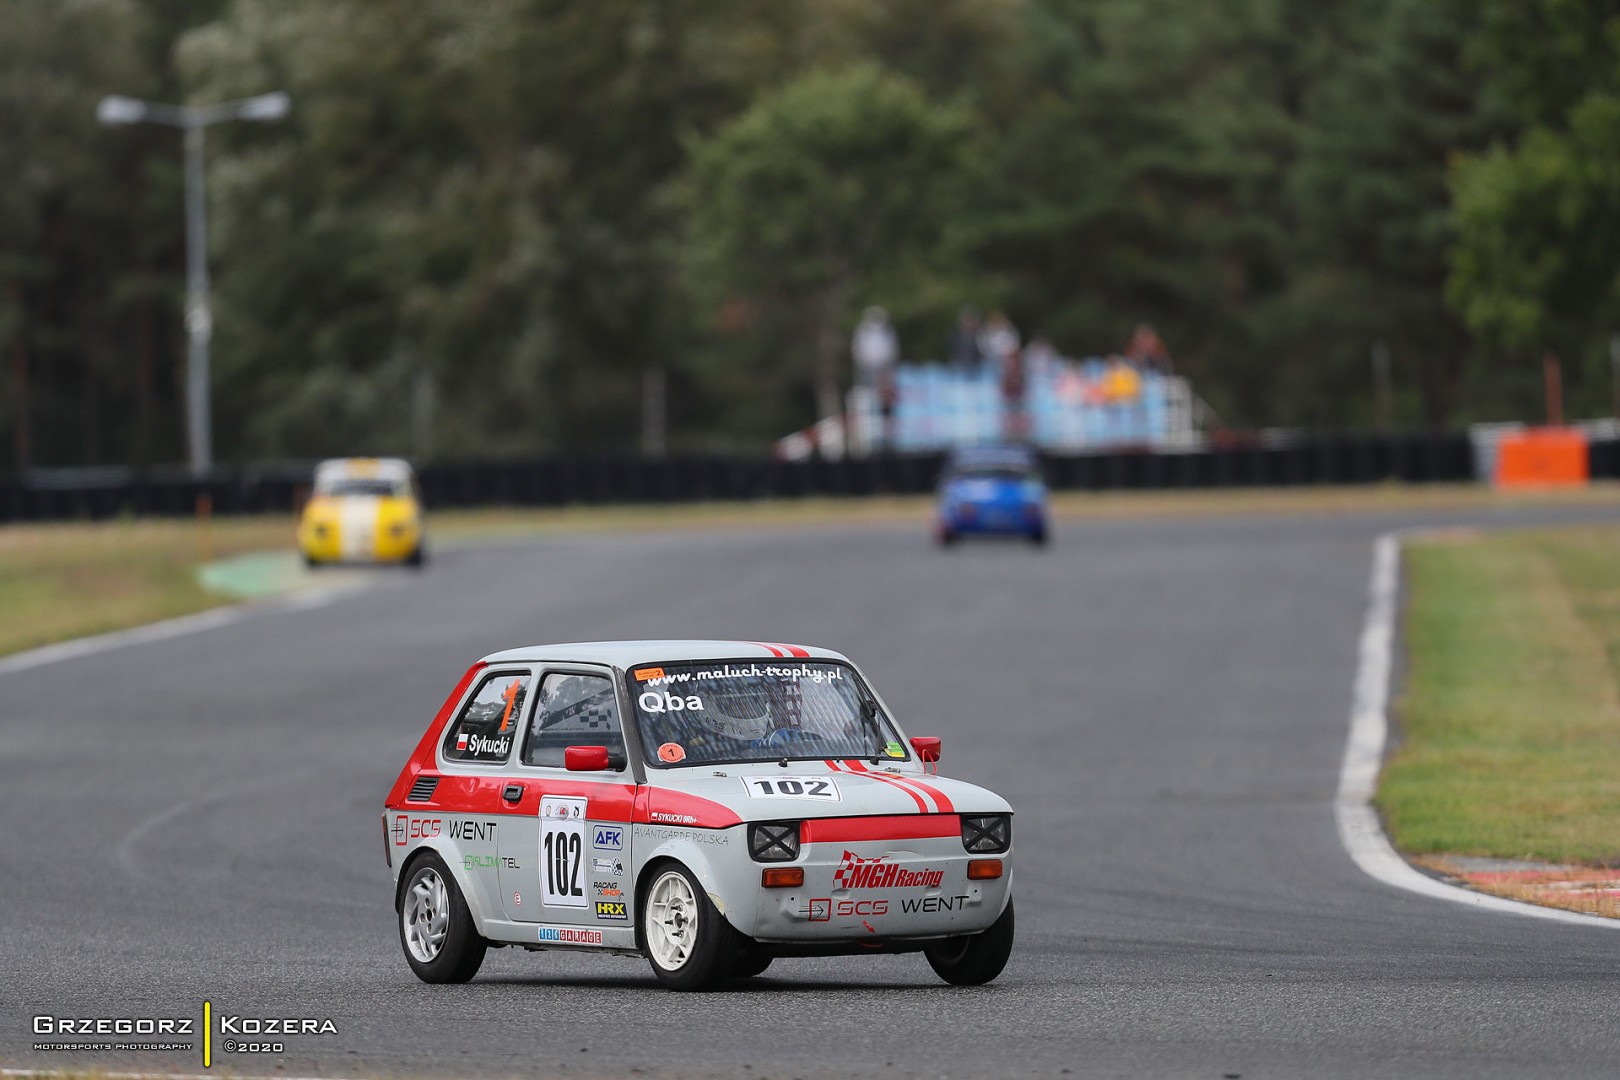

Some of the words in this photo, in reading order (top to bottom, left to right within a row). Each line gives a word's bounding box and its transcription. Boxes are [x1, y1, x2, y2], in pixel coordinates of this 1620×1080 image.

[647, 664, 843, 688] www.maluch-trophy.pl
[501, 679, 521, 731] 1
[638, 692, 704, 714] Qba
[469, 733, 510, 757] Sykucki
[668, 748, 675, 757] 1
[753, 780, 832, 797] 102
[658, 812, 683, 823] SYKUCKI
[411, 819, 442, 838] SCS
[449, 819, 497, 841] WENT
[595, 830, 622, 846] AFK
[692, 832, 730, 846] POLSKA
[544, 831, 583, 897] 102
[593, 881, 618, 890] RACING
[850, 863, 899, 889] MGH
[898, 868, 944, 888] Racing
[597, 902, 625, 915] HRX
[836, 899, 889, 916] SCS
[901, 895, 969, 914] WENT
